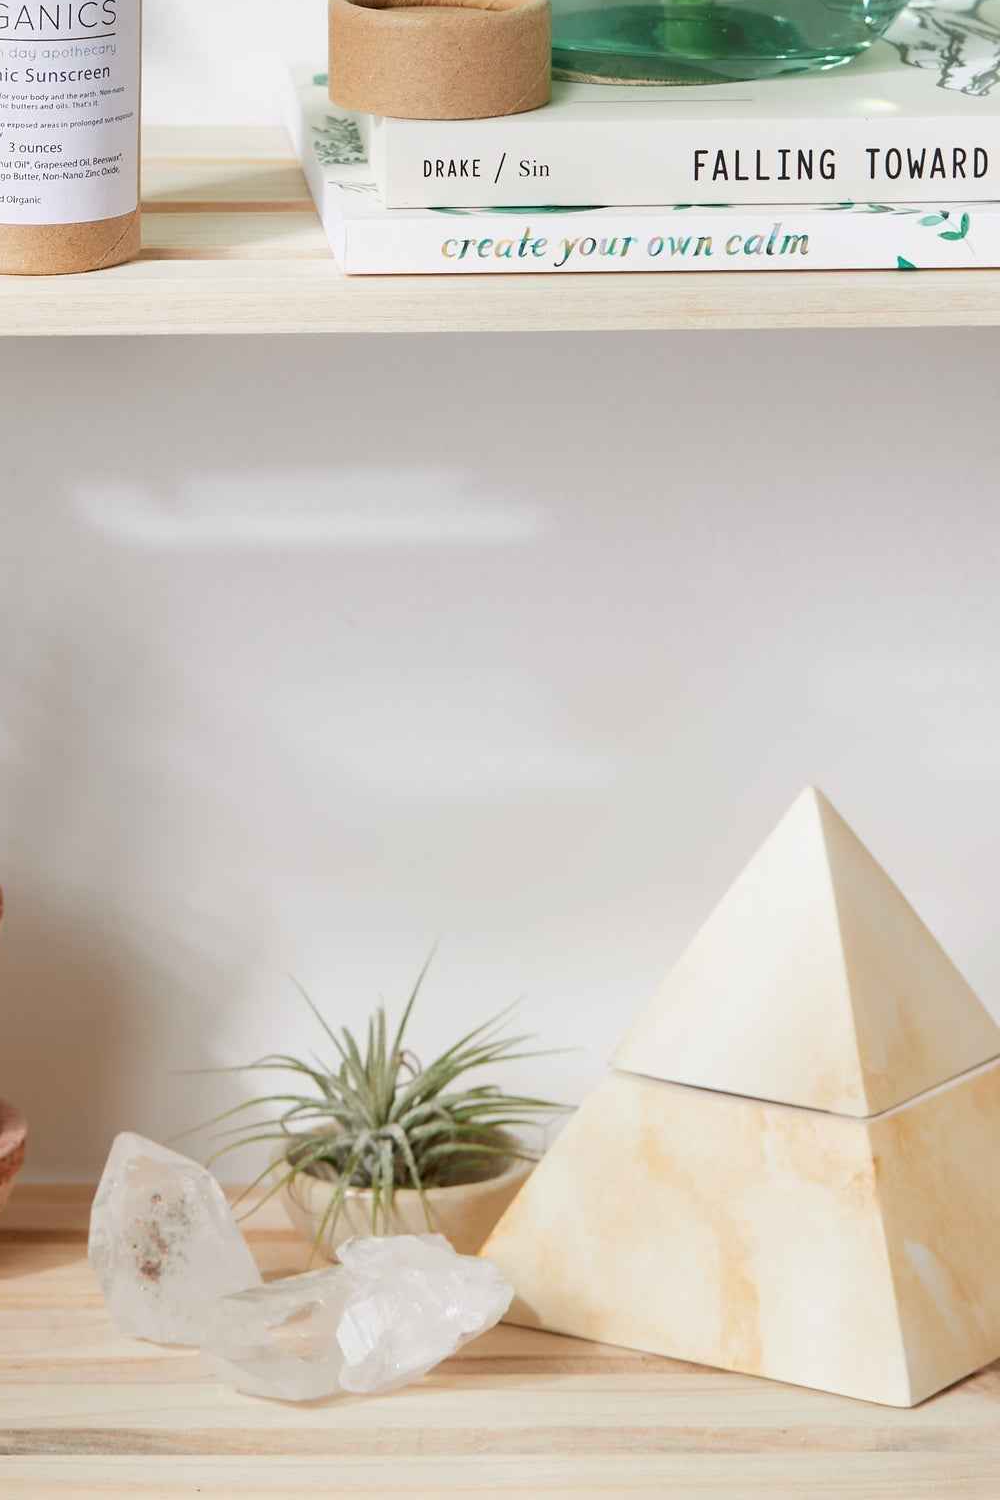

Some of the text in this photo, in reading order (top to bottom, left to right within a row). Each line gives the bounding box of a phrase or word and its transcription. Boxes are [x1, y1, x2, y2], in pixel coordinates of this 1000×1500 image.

[8, 45, 36, 62] day
[41, 43, 117, 60] apothecary
[25, 66, 111, 83] Sunscreen
[0, 92, 9, 100] for
[11, 93, 28, 101] your
[30, 93, 49, 102] body
[51, 92, 65, 100] and
[11, 101, 38, 110] butters
[40, 102, 53, 110] and
[7, 120, 38, 129] exposed
[70, 117, 104, 128] prolonged
[8, 142, 64, 153] 3 ounces
[34, 159, 78, 171] Grapeseed
[423, 159, 481, 178] DRAKE
[519, 159, 550, 178] Sin
[694, 147, 989, 181] FALLING TOWARD
[13, 172, 41, 181] Butter,
[42, 172, 84, 181] Non-Nano
[85, 169, 101, 178] Zinc
[441, 222, 809, 268] create your own calm
